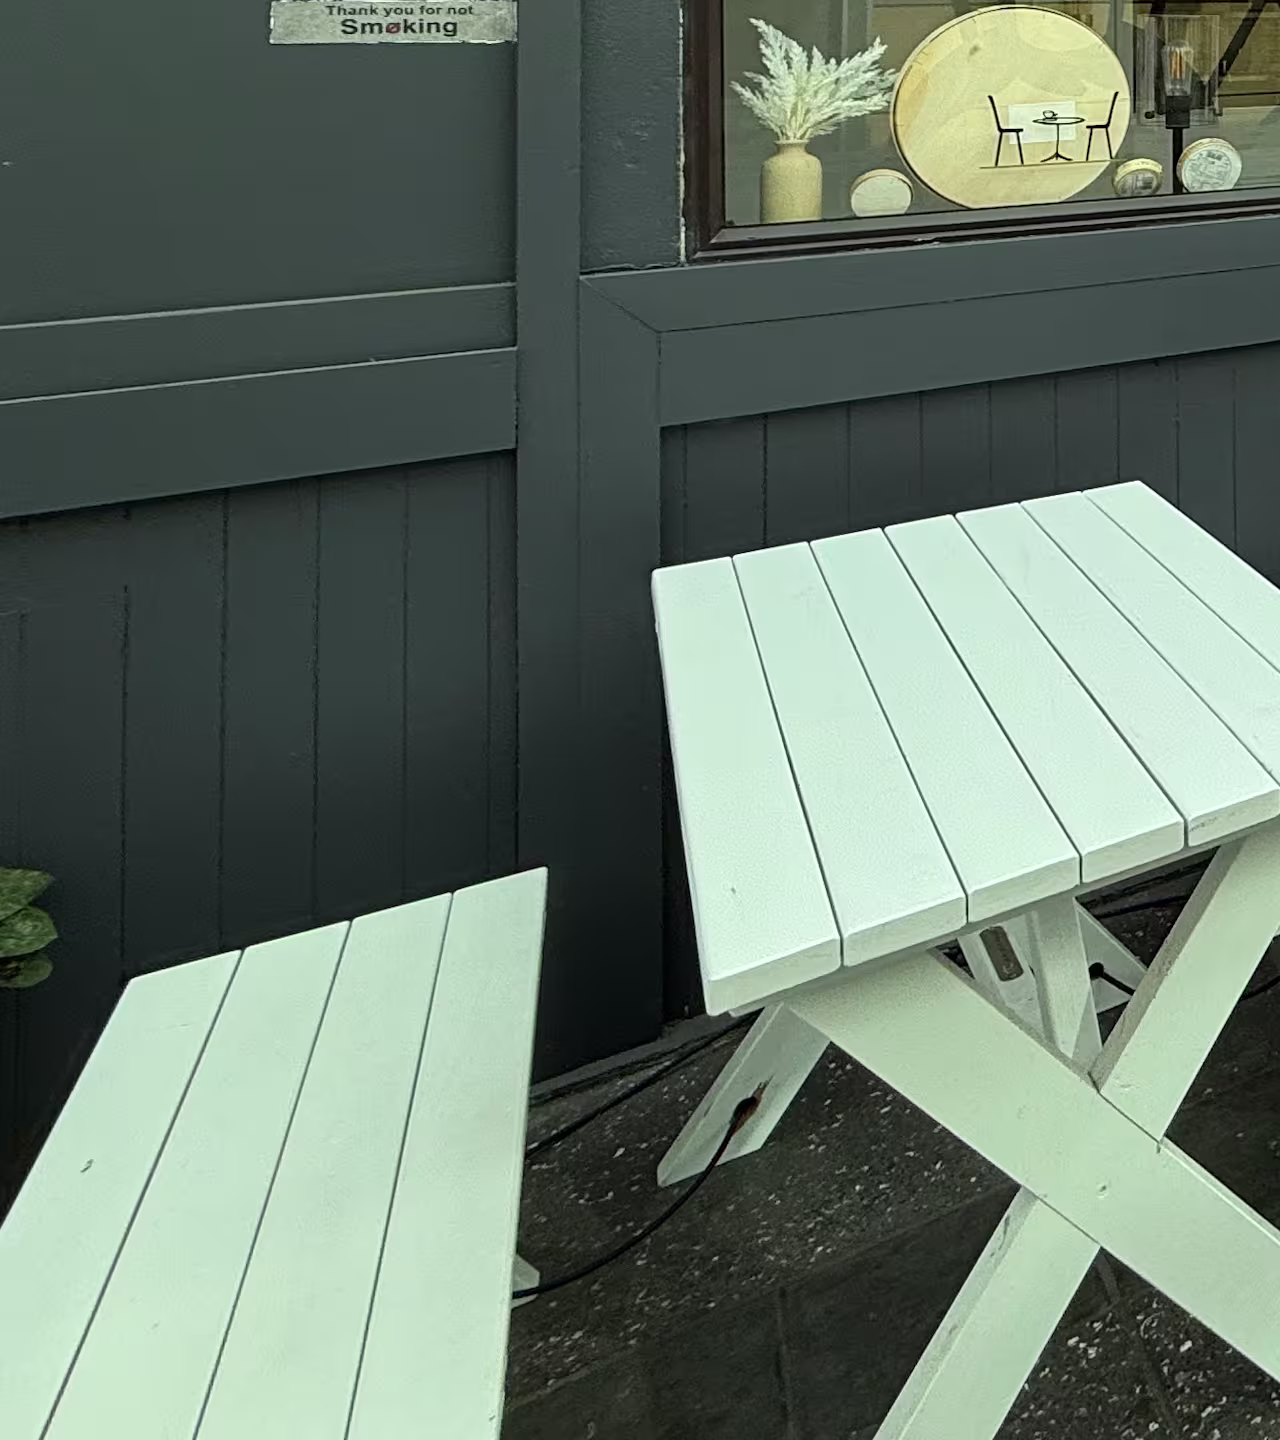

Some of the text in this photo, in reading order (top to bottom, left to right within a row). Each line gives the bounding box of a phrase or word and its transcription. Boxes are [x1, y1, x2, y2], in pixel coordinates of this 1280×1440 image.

[325, 4, 474, 18] Thank you for not
